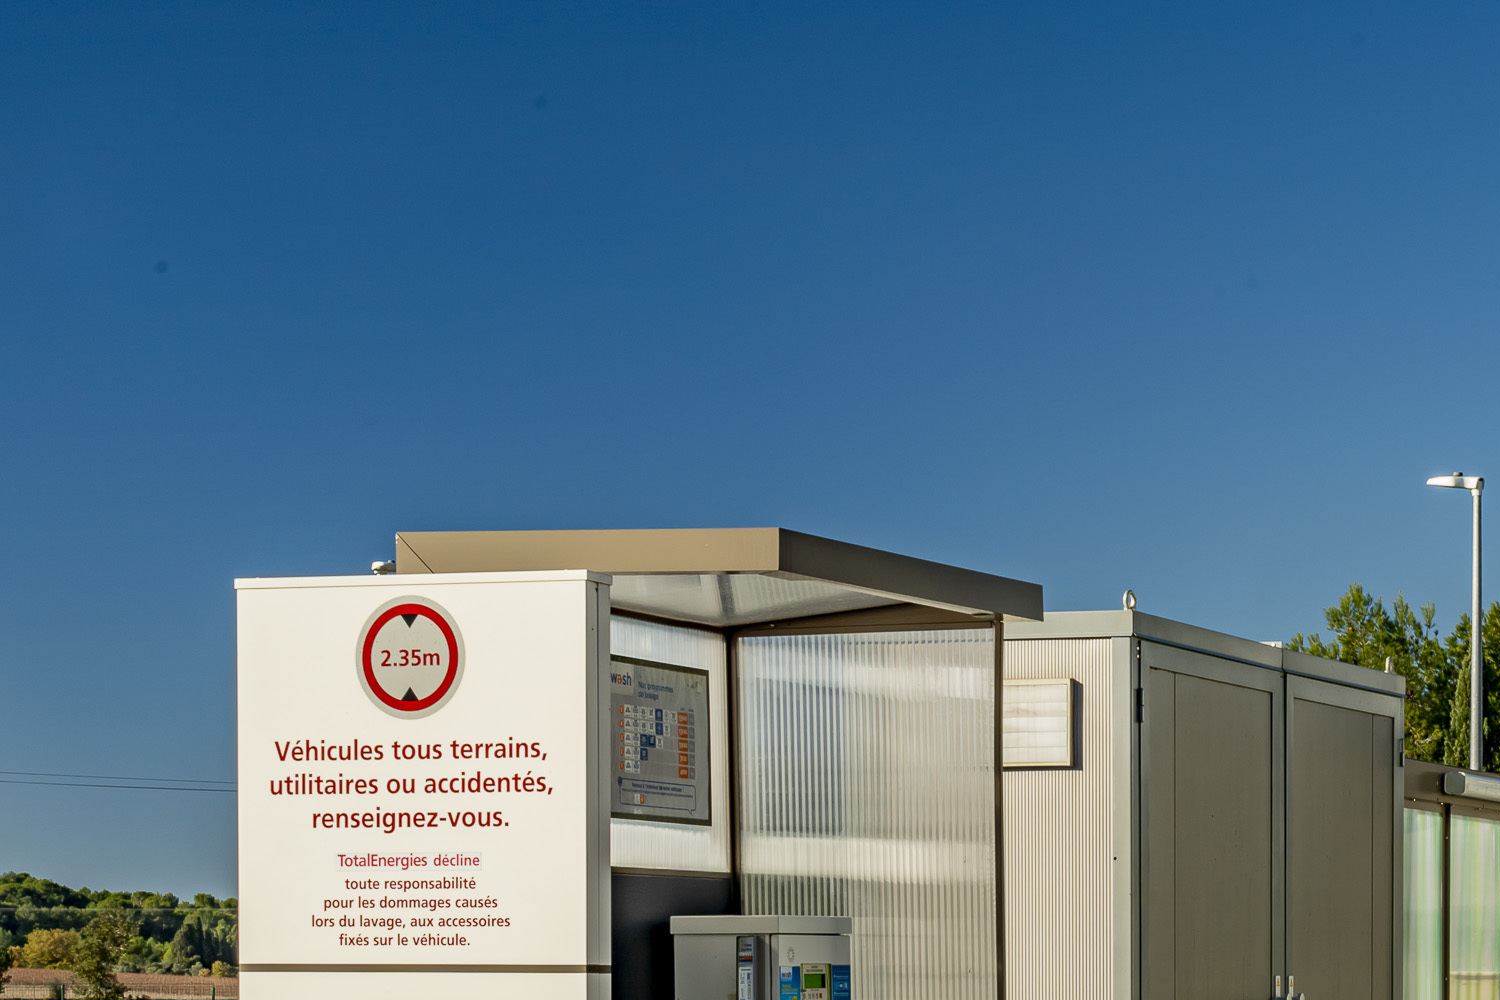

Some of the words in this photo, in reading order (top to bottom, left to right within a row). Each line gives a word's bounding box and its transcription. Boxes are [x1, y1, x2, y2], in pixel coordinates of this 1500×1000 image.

[381, 649, 440, 666] 2.35m
[611, 671, 632, 686] wash
[275, 739, 383, 761] Véhicules
[392, 741, 442, 760] tous
[450, 737, 547, 760] terrains,
[271, 773, 378, 795] utilitaires
[387, 779, 415, 794] ou
[424, 771, 552, 795] accidentés,
[313, 807, 508, 833] renseignez-vous.
[338, 853, 427, 870] TotalEnergies
[434, 854, 479, 866] décline
[345, 879, 379, 889] toute
[385, 877, 476, 892] responsabilité
[324, 900, 354, 911] pour
[359, 896, 375, 908] les
[380, 896, 450, 911] dommages
[456, 896, 497, 908] causés
[312, 915, 334, 927] lors
[339, 915, 355, 927] du
[360, 915, 405, 930] lavage,
[411, 918, 433, 927] aux
[438, 915, 510, 927] accessoires
[339, 933, 369, 946] fixés
[374, 937, 393, 945] sur
[398, 934, 408, 945] le
[413, 934, 470, 945] véhicule.
